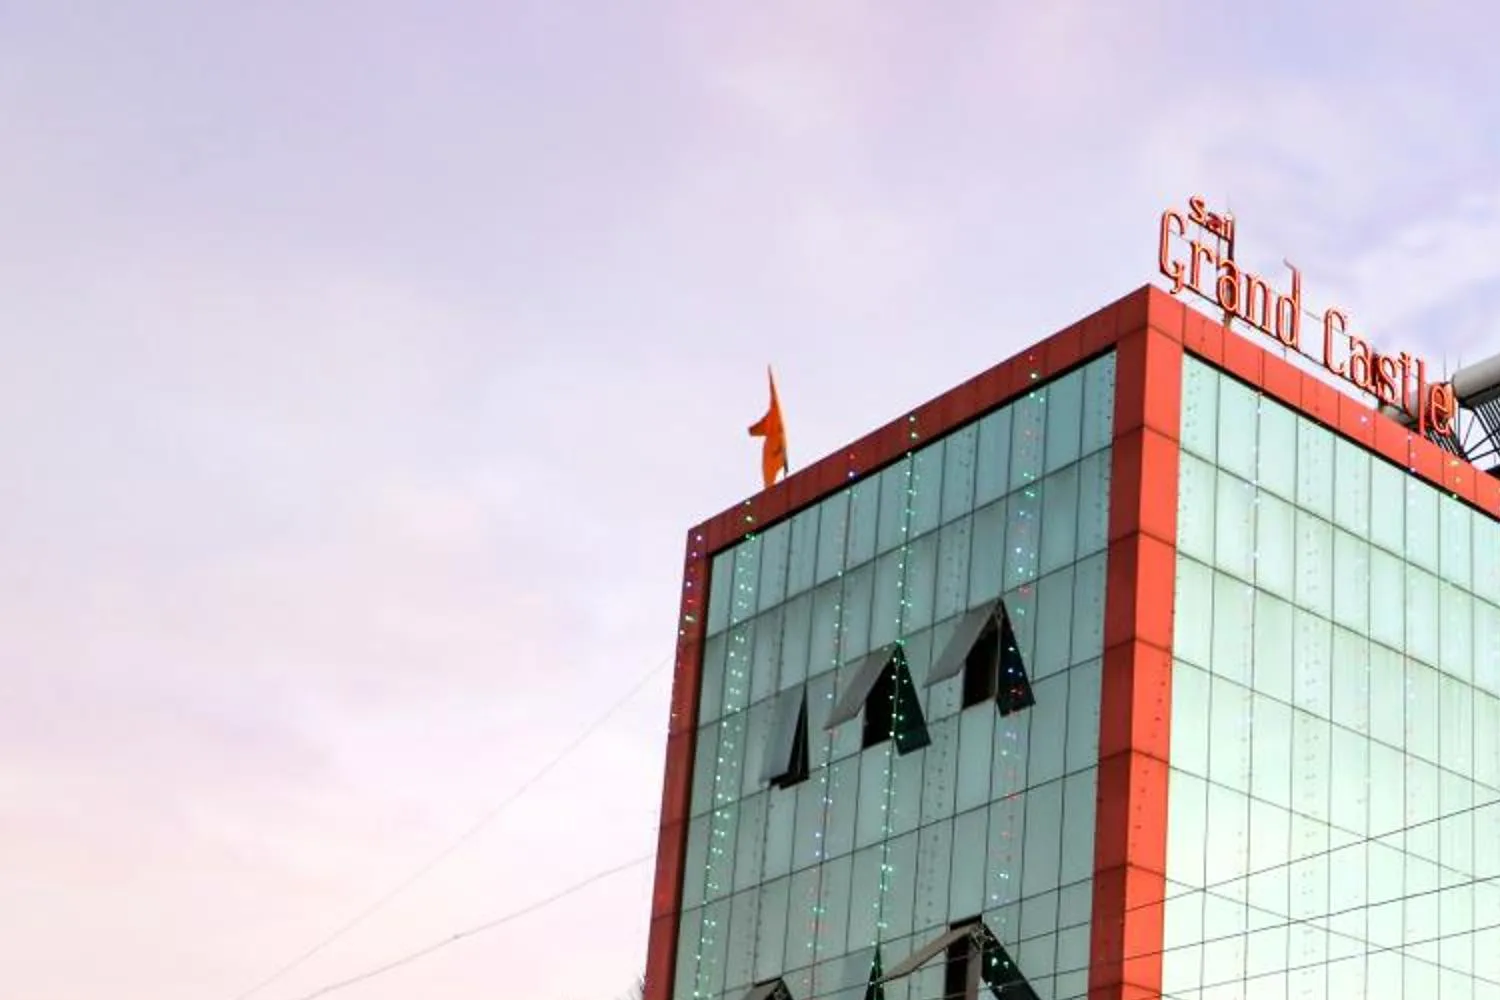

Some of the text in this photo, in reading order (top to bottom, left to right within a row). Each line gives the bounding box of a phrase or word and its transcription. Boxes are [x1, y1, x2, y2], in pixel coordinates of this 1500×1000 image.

[1188, 195, 1234, 240] Sai
[1159, 207, 1458, 436] Grand Castle
